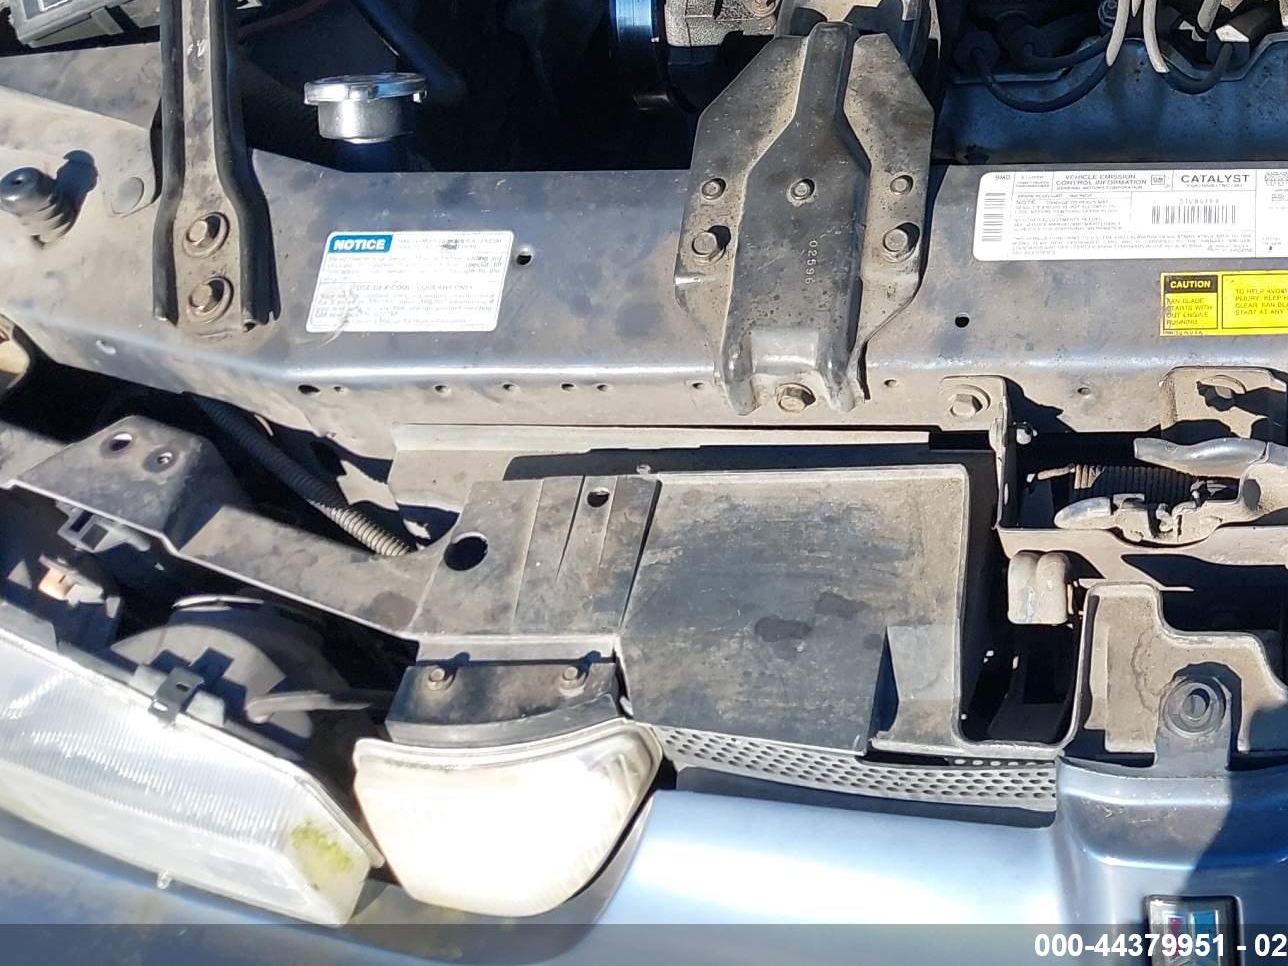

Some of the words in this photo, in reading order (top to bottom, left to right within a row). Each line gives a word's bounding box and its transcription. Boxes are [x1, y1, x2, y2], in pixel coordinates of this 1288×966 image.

[1181, 174, 1250, 183] CATALYST
[333, 238, 386, 251] NOTICE
[804, 240, 819, 284] 02596
[1170, 280, 1211, 289] CAUTION
